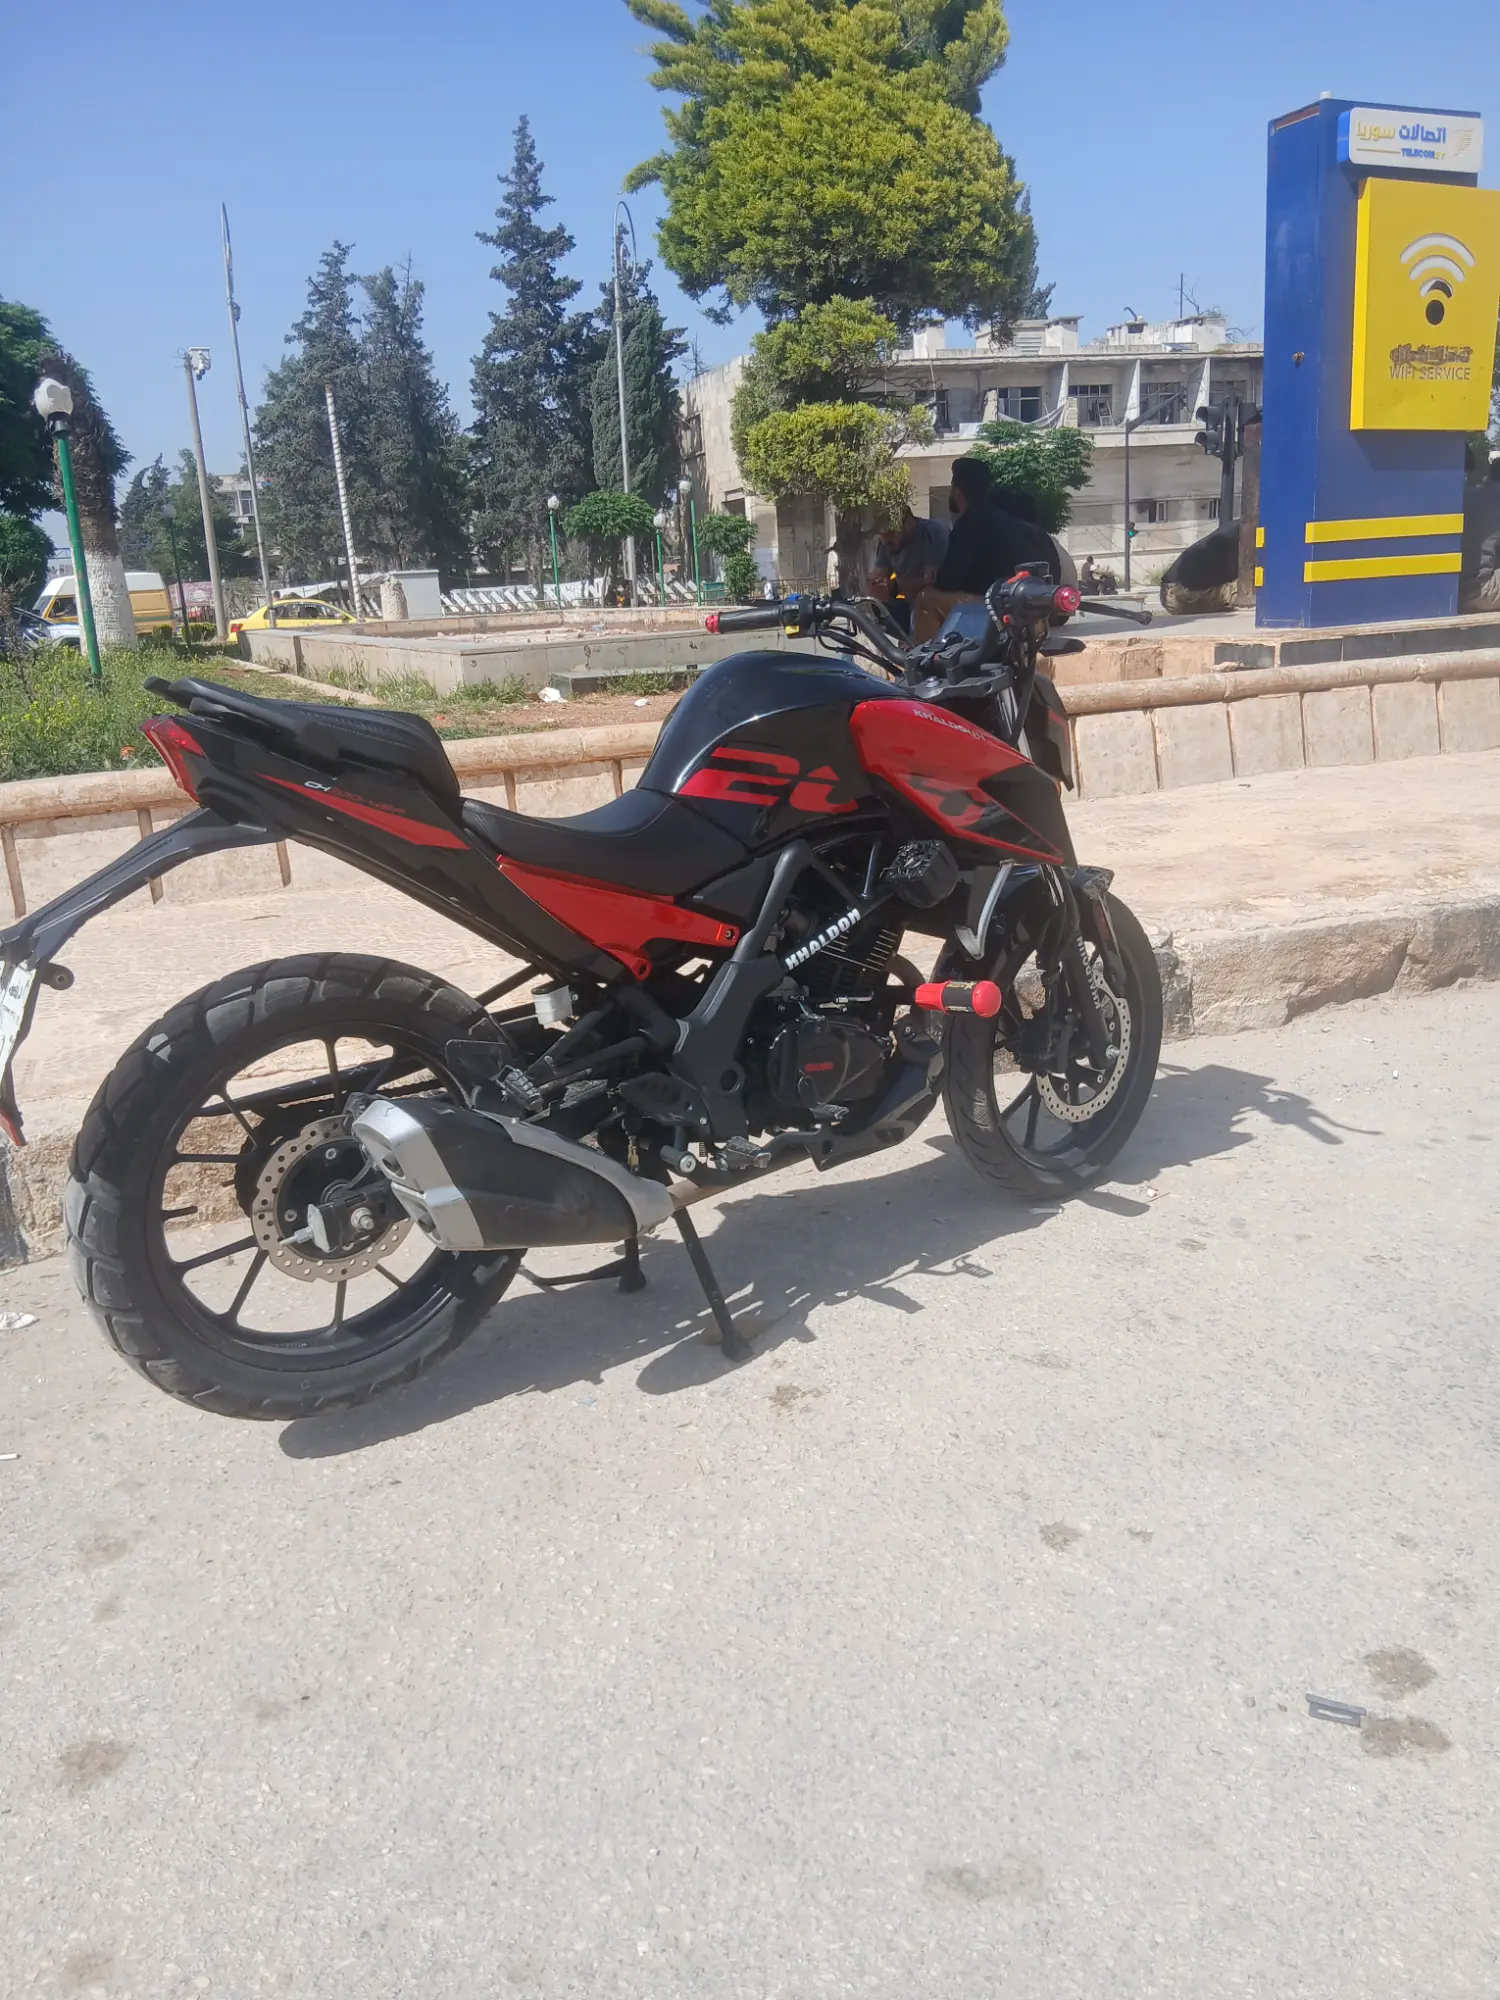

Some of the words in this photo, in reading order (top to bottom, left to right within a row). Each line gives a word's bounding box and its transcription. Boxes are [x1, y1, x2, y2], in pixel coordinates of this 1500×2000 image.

[1356, 121, 1395, 141] سوريا
[1399, 124, 1446, 144] اتصالات
[1389, 365, 1415, 379] WIFI
[1419, 366, 1471, 380] SERVICE
